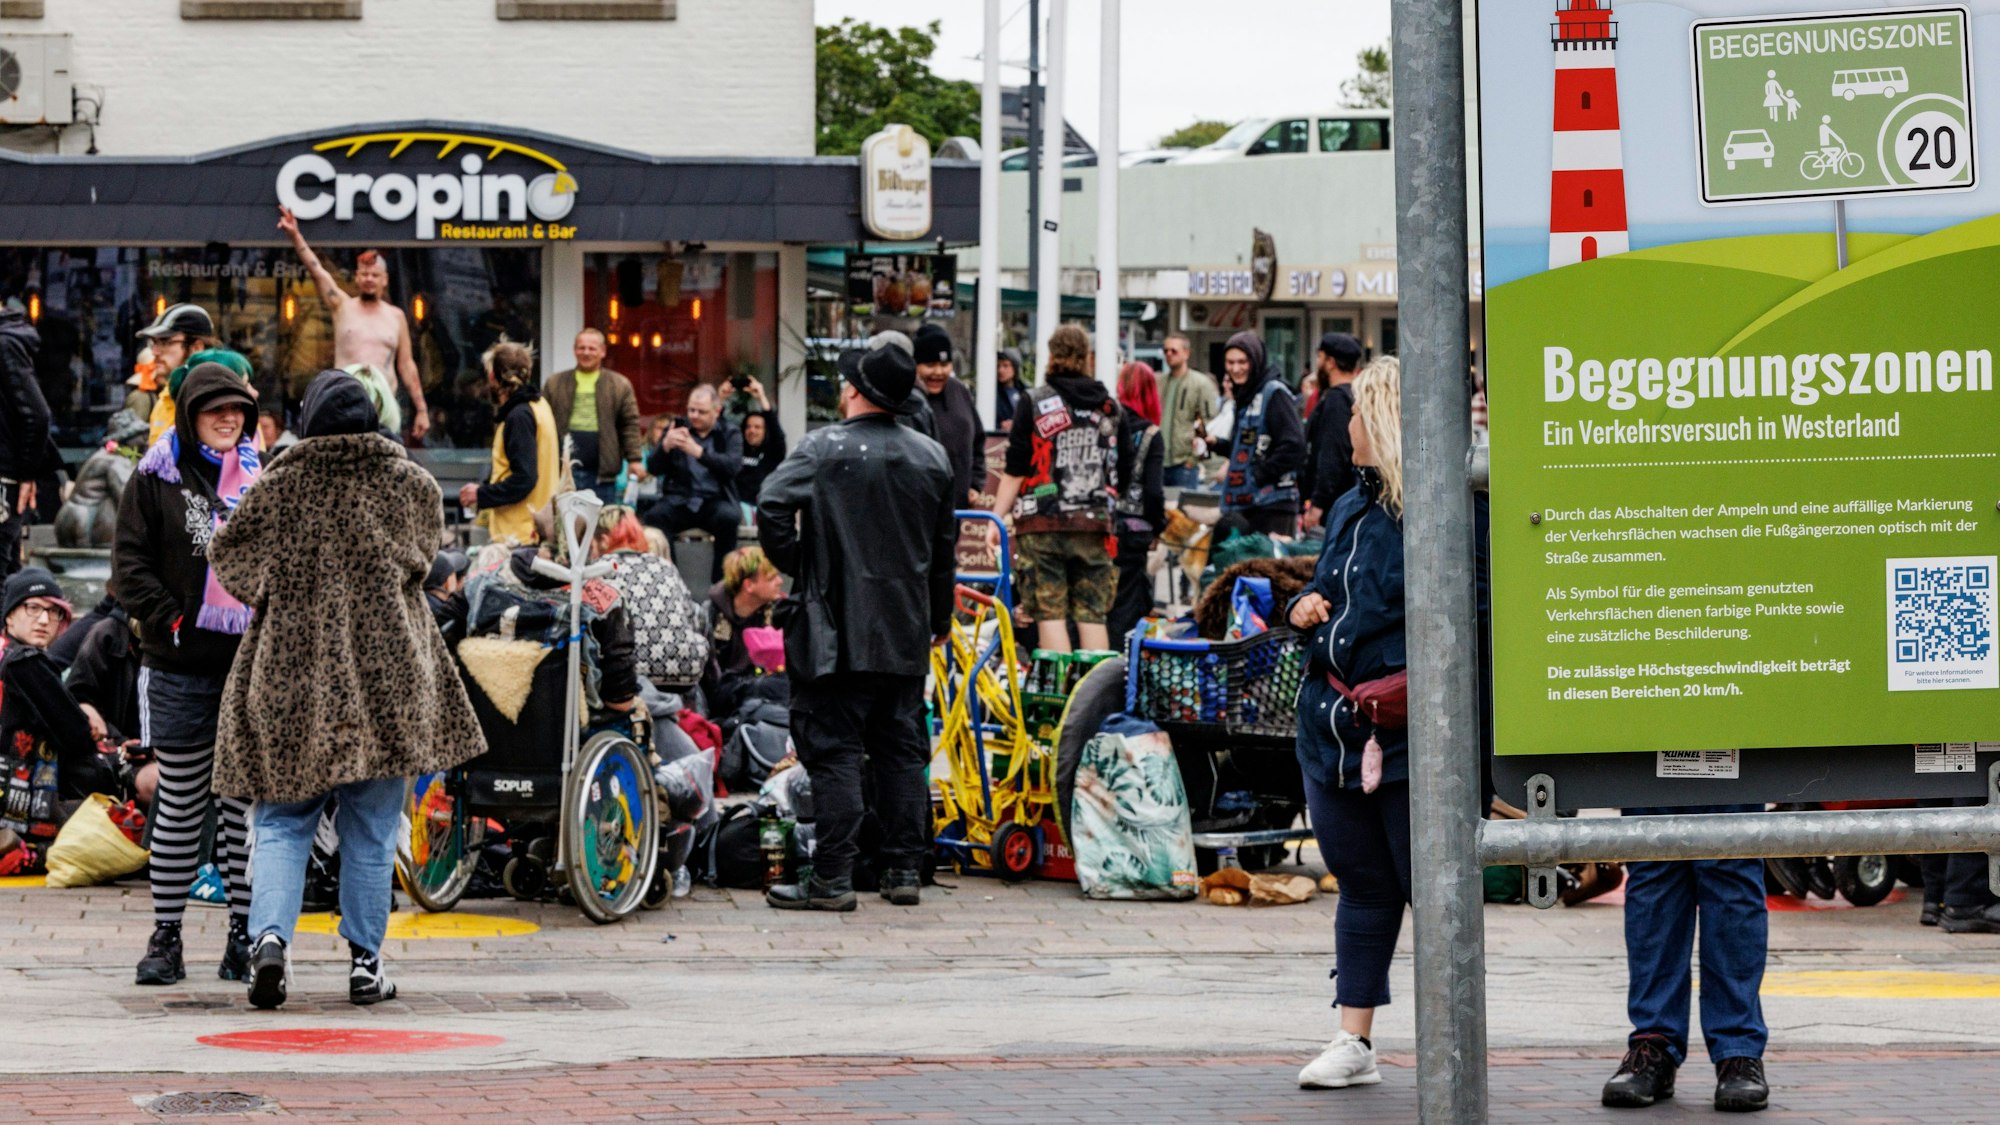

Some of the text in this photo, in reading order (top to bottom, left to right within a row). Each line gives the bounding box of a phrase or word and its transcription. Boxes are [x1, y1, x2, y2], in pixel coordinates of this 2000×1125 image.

[1708, 21, 1953, 60] BEGEGNUNGSZONE
[1907, 125, 1957, 171] 20
[276, 153, 578, 239] Cropino
[441, 223, 577, 239] Restaurant & Bar
[149, 260, 248, 277] Restaurant
[254, 261, 266, 276] &
[1543, 346, 1993, 410] Begegnungszonen
[1543, 411, 1900, 446] Ein Verkehrsversuch in Westerland
[1544, 498, 1973, 521] Durch das Abschalten der Ampeln und eine auffällige Markierung
[1544, 518, 1978, 543] der Verkehrsflächen wachsen die Fußgängerzonen optisch mit der
[1545, 551, 1666, 565] Straße zusammen.
[1545, 582, 1814, 602] Als Symbol für die gemeinsam genutzten
[1546, 601, 1845, 622] Verkehrsflächen dienen farbige Punkte sowie
[1546, 626, 1752, 644] eine zusätzliche Beschilderung.
[1547, 658, 1851, 680] Die zulässige Höchstgeschwindigkeit beträgt
[1940, 668, 1984, 676] Informationen
[1547, 682, 1743, 701] in diesen Bereichen 20 km/h.
[493, 779, 534, 792] SOPUR
